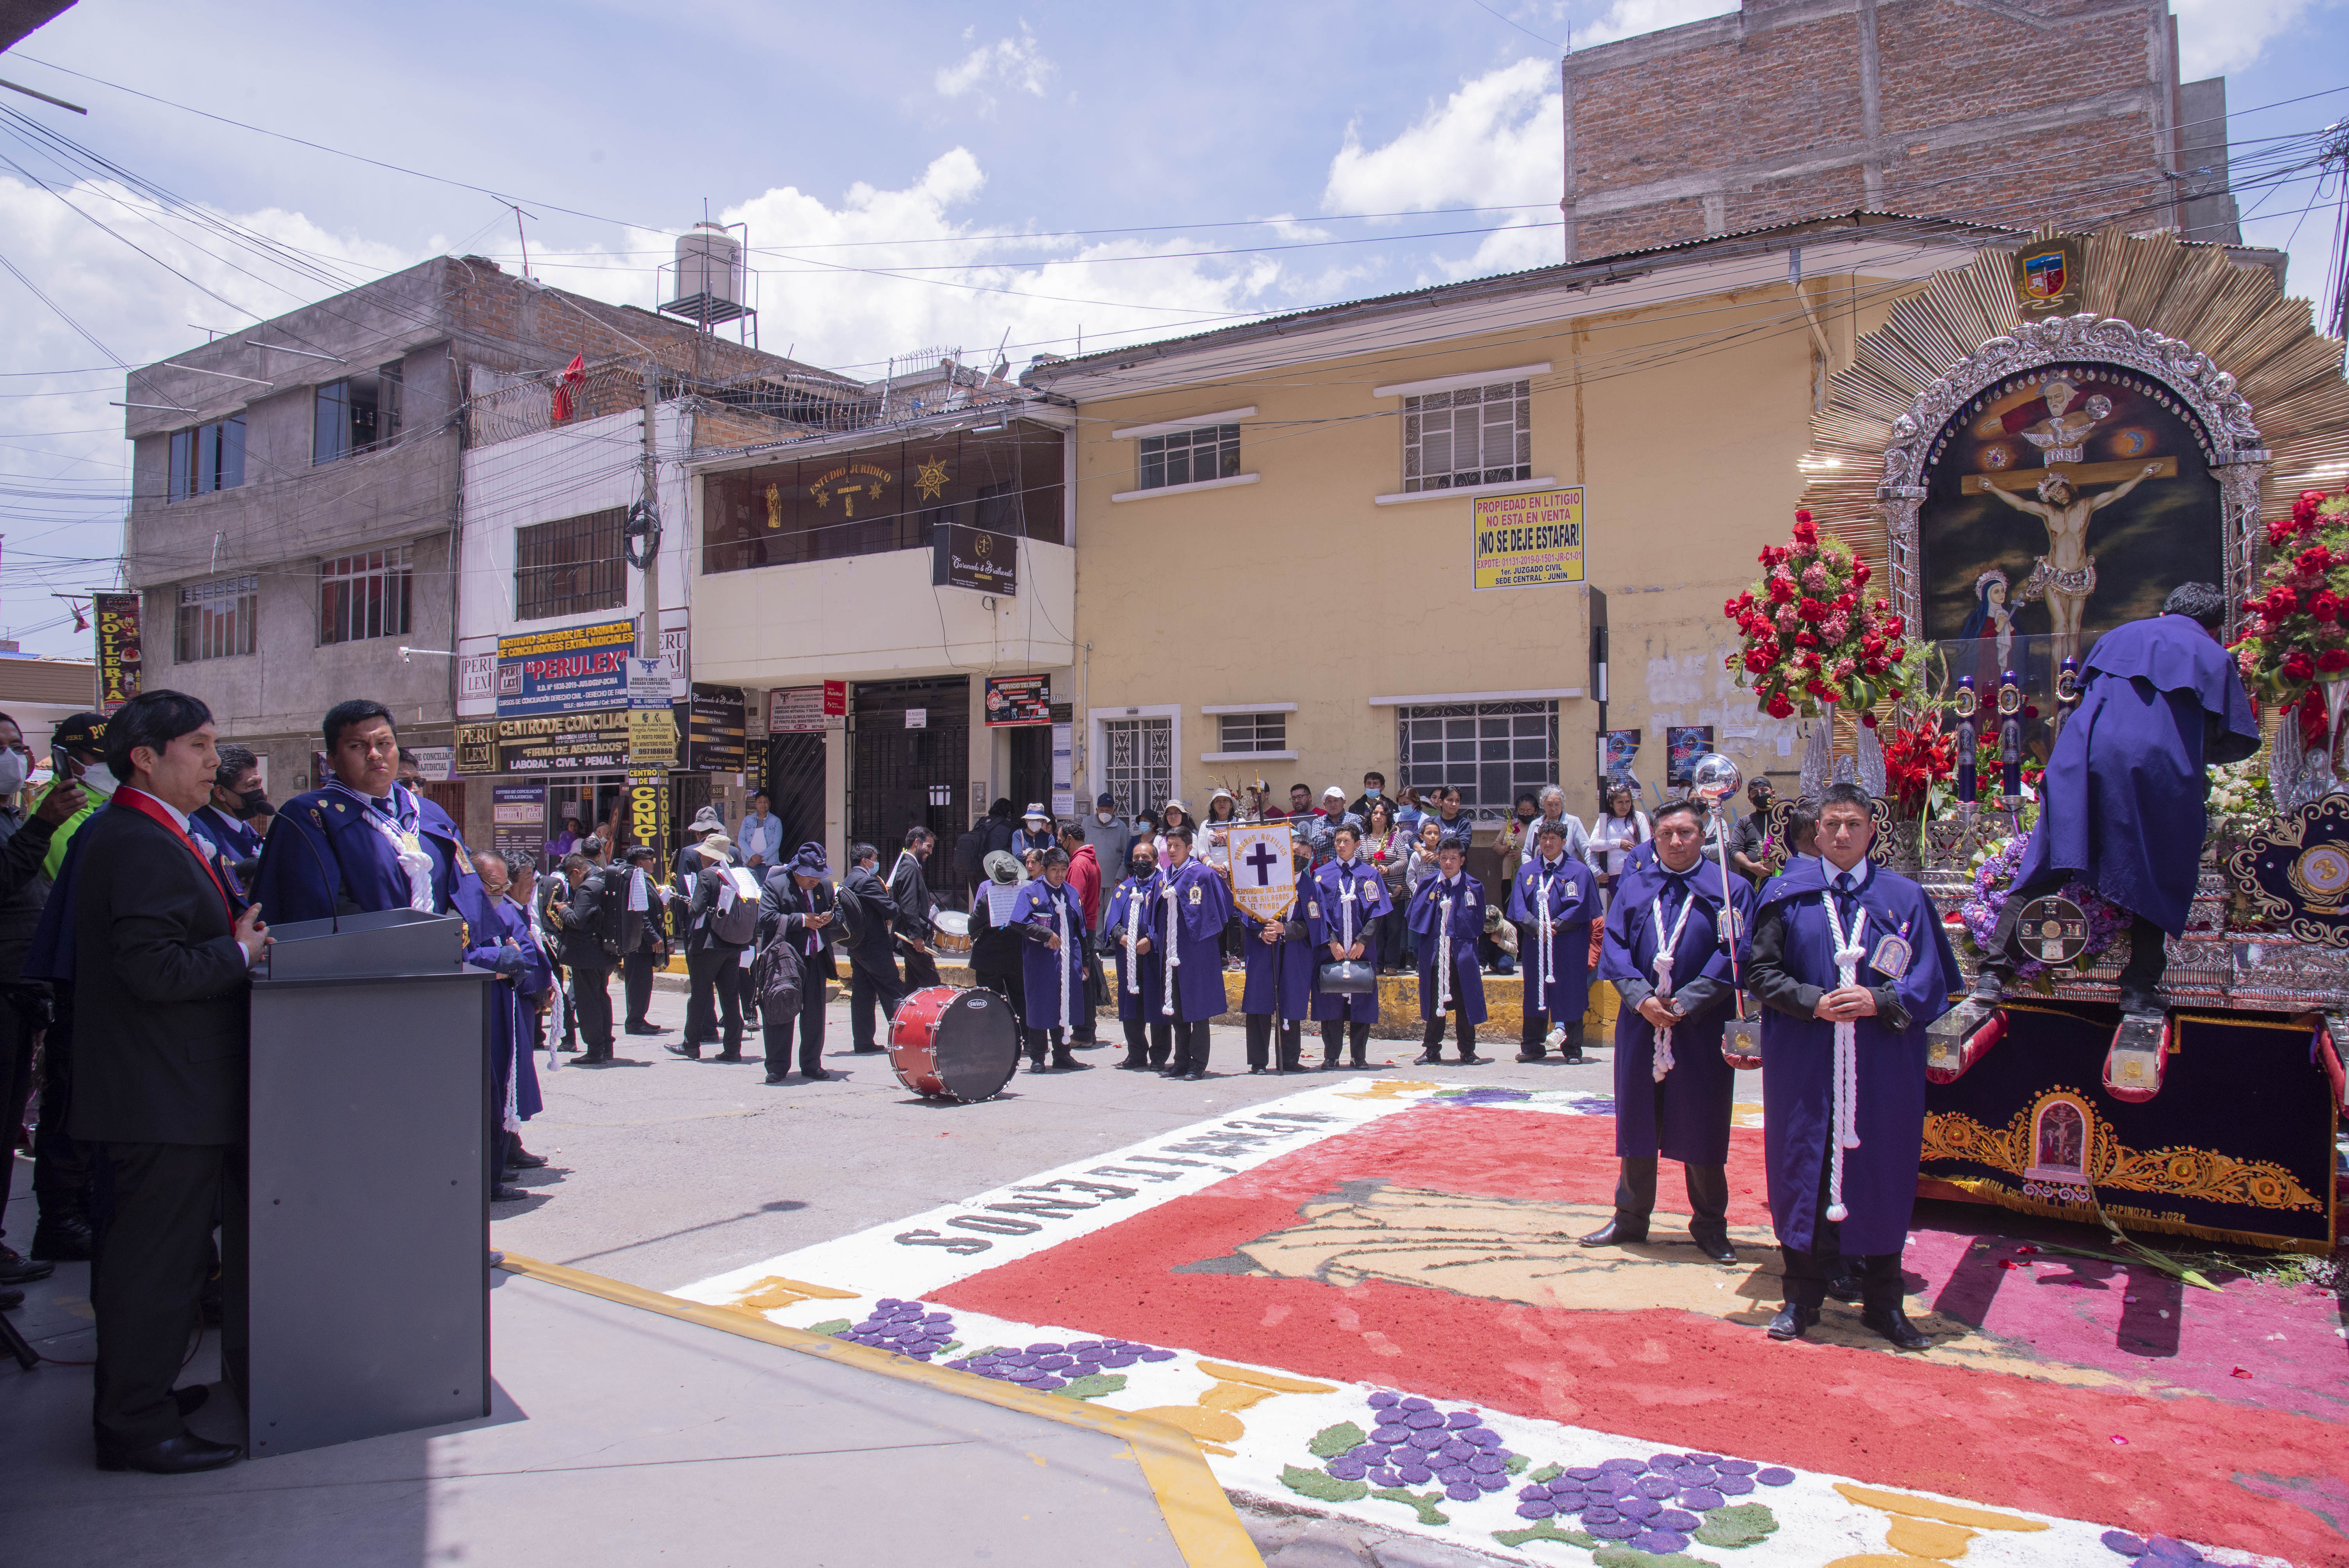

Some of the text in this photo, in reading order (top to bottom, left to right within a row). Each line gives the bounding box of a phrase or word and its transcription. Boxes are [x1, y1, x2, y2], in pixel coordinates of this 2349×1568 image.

[2051, 450, 2077, 460] INRI
[810, 463, 891, 495] ESTUDIO JURÍDICO
[838, 485, 861, 494] ABOGADOS
[1477, 493, 1580, 513] PROPIEDAD EN LITIGIO
[1486, 508, 1570, 527] NO ESTA EN VENTA
[1479, 523, 1579, 558] ¡NO SE DEJE ESTAFAR!
[952, 555, 979, 570] Coronado
[985, 560, 1013, 577] Brathwaite
[1477, 551, 1581, 569] EXPDTE: 01131-2019-0-1501-JR-C1-01
[1513, 565, 1543, 574] JUZGADO
[1513, 575, 1542, 583] CENTRAL
[1548, 572, 1567, 580] JUNÍN
[499, 621, 632, 648] INSTITUTO SUPERIOR DE FORMACIÓN
[497, 633, 634, 658] DE CONCILIADORES EXTRAJUDICIALES
[101, 613, 125, 699] POLLERÍA
[465, 657, 496, 674] PERU
[501, 665, 521, 676] PERU
[469, 676, 487, 690] LEX
[503, 678, 517, 688] LEX
[522, 695, 549, 704] CONCILIACIÓN
[692, 692, 715, 702] Coronado
[499, 719, 547, 736] CENTRO
[547, 718, 565, 733] DE
[459, 728, 494, 743] PERU
[465, 747, 487, 762] LEX
[556, 747, 568, 755] DE
[510, 759, 549, 769] LABORAL
[556, 757, 578, 767] CIVIL
[585, 756, 614, 766] PENAL
[1261, 833, 1287, 856] AUXILIOS
[2313, 859, 2338, 880] 3
[1277, 884, 1293, 892] SEÑOR
[1260, 893, 1289, 902] MILAGROS
[2105, 1204, 2151, 1218] ESPINOZA
[2160, 1211, 2186, 1223] 2022
